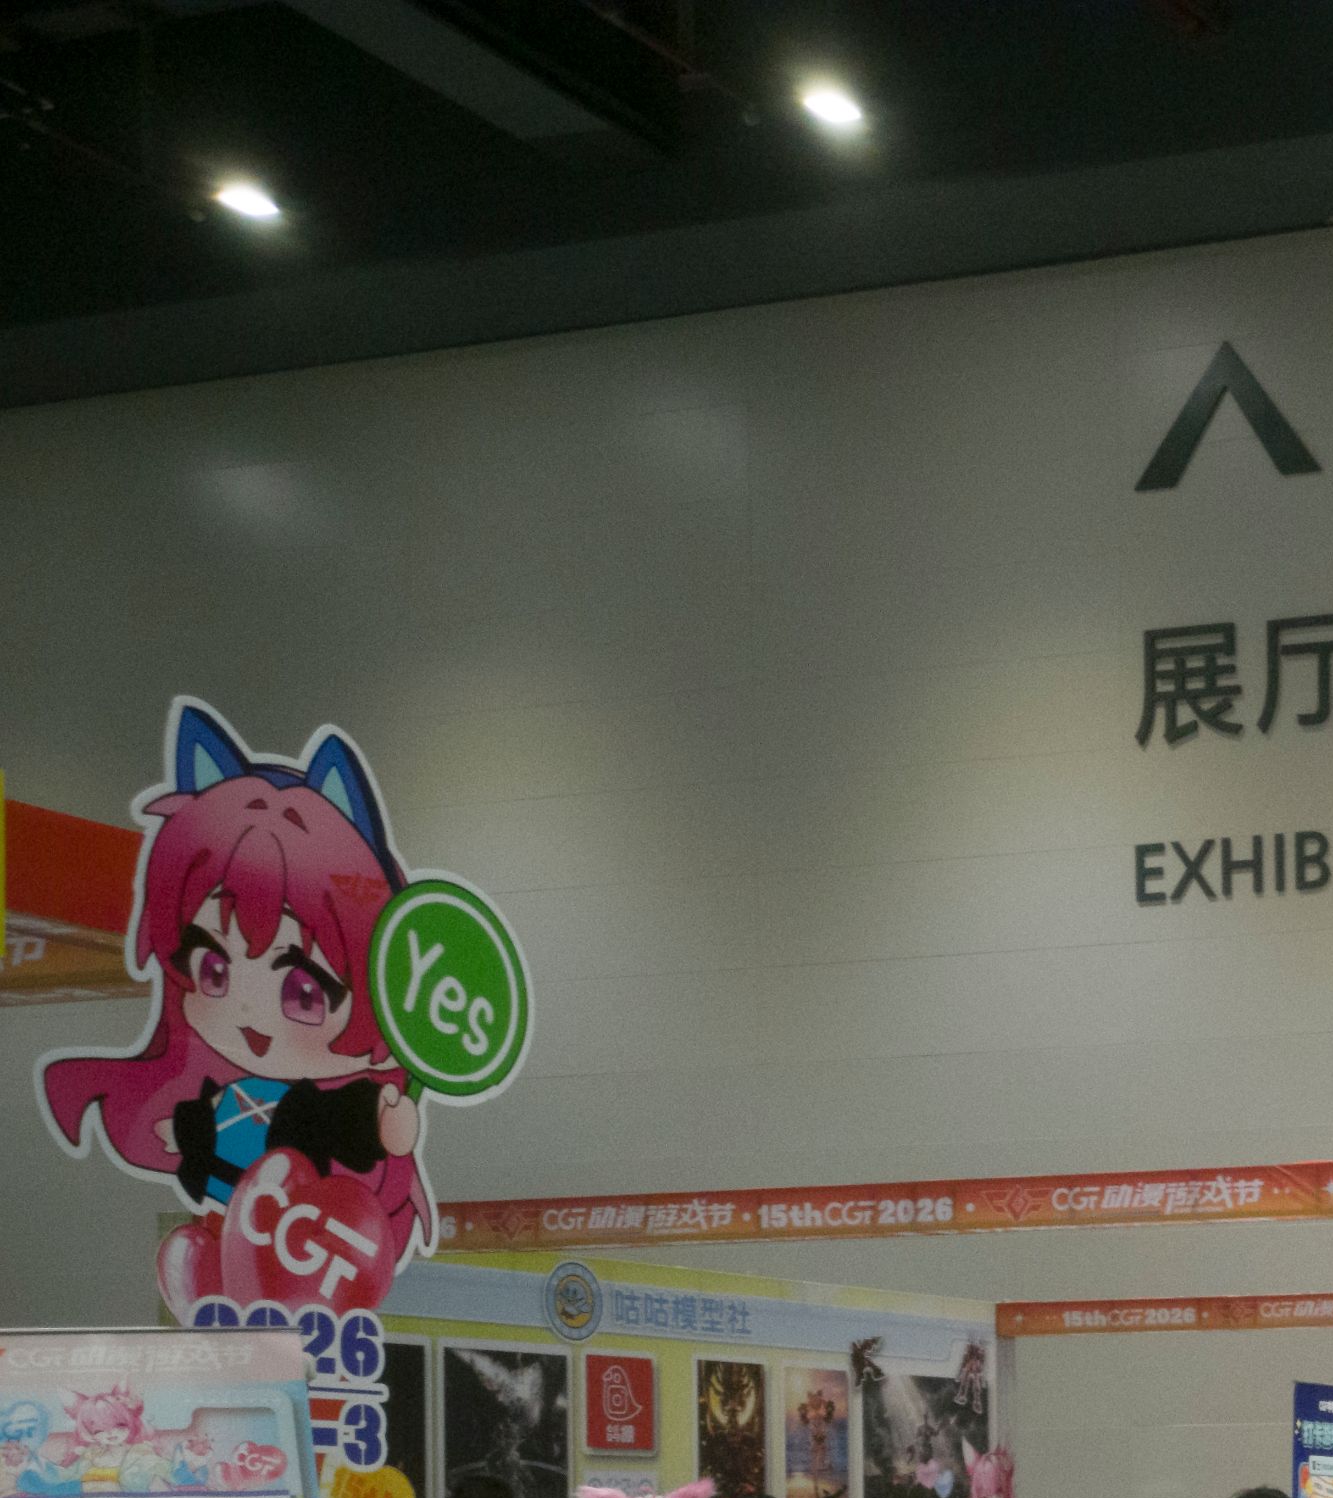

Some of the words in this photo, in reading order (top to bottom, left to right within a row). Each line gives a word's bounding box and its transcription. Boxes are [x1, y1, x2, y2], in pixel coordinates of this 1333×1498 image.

[405, 928, 495, 1057] Yes
[240, 1186, 379, 1298] CGT
[613, 1289, 752, 1335] 咕咕模型社
